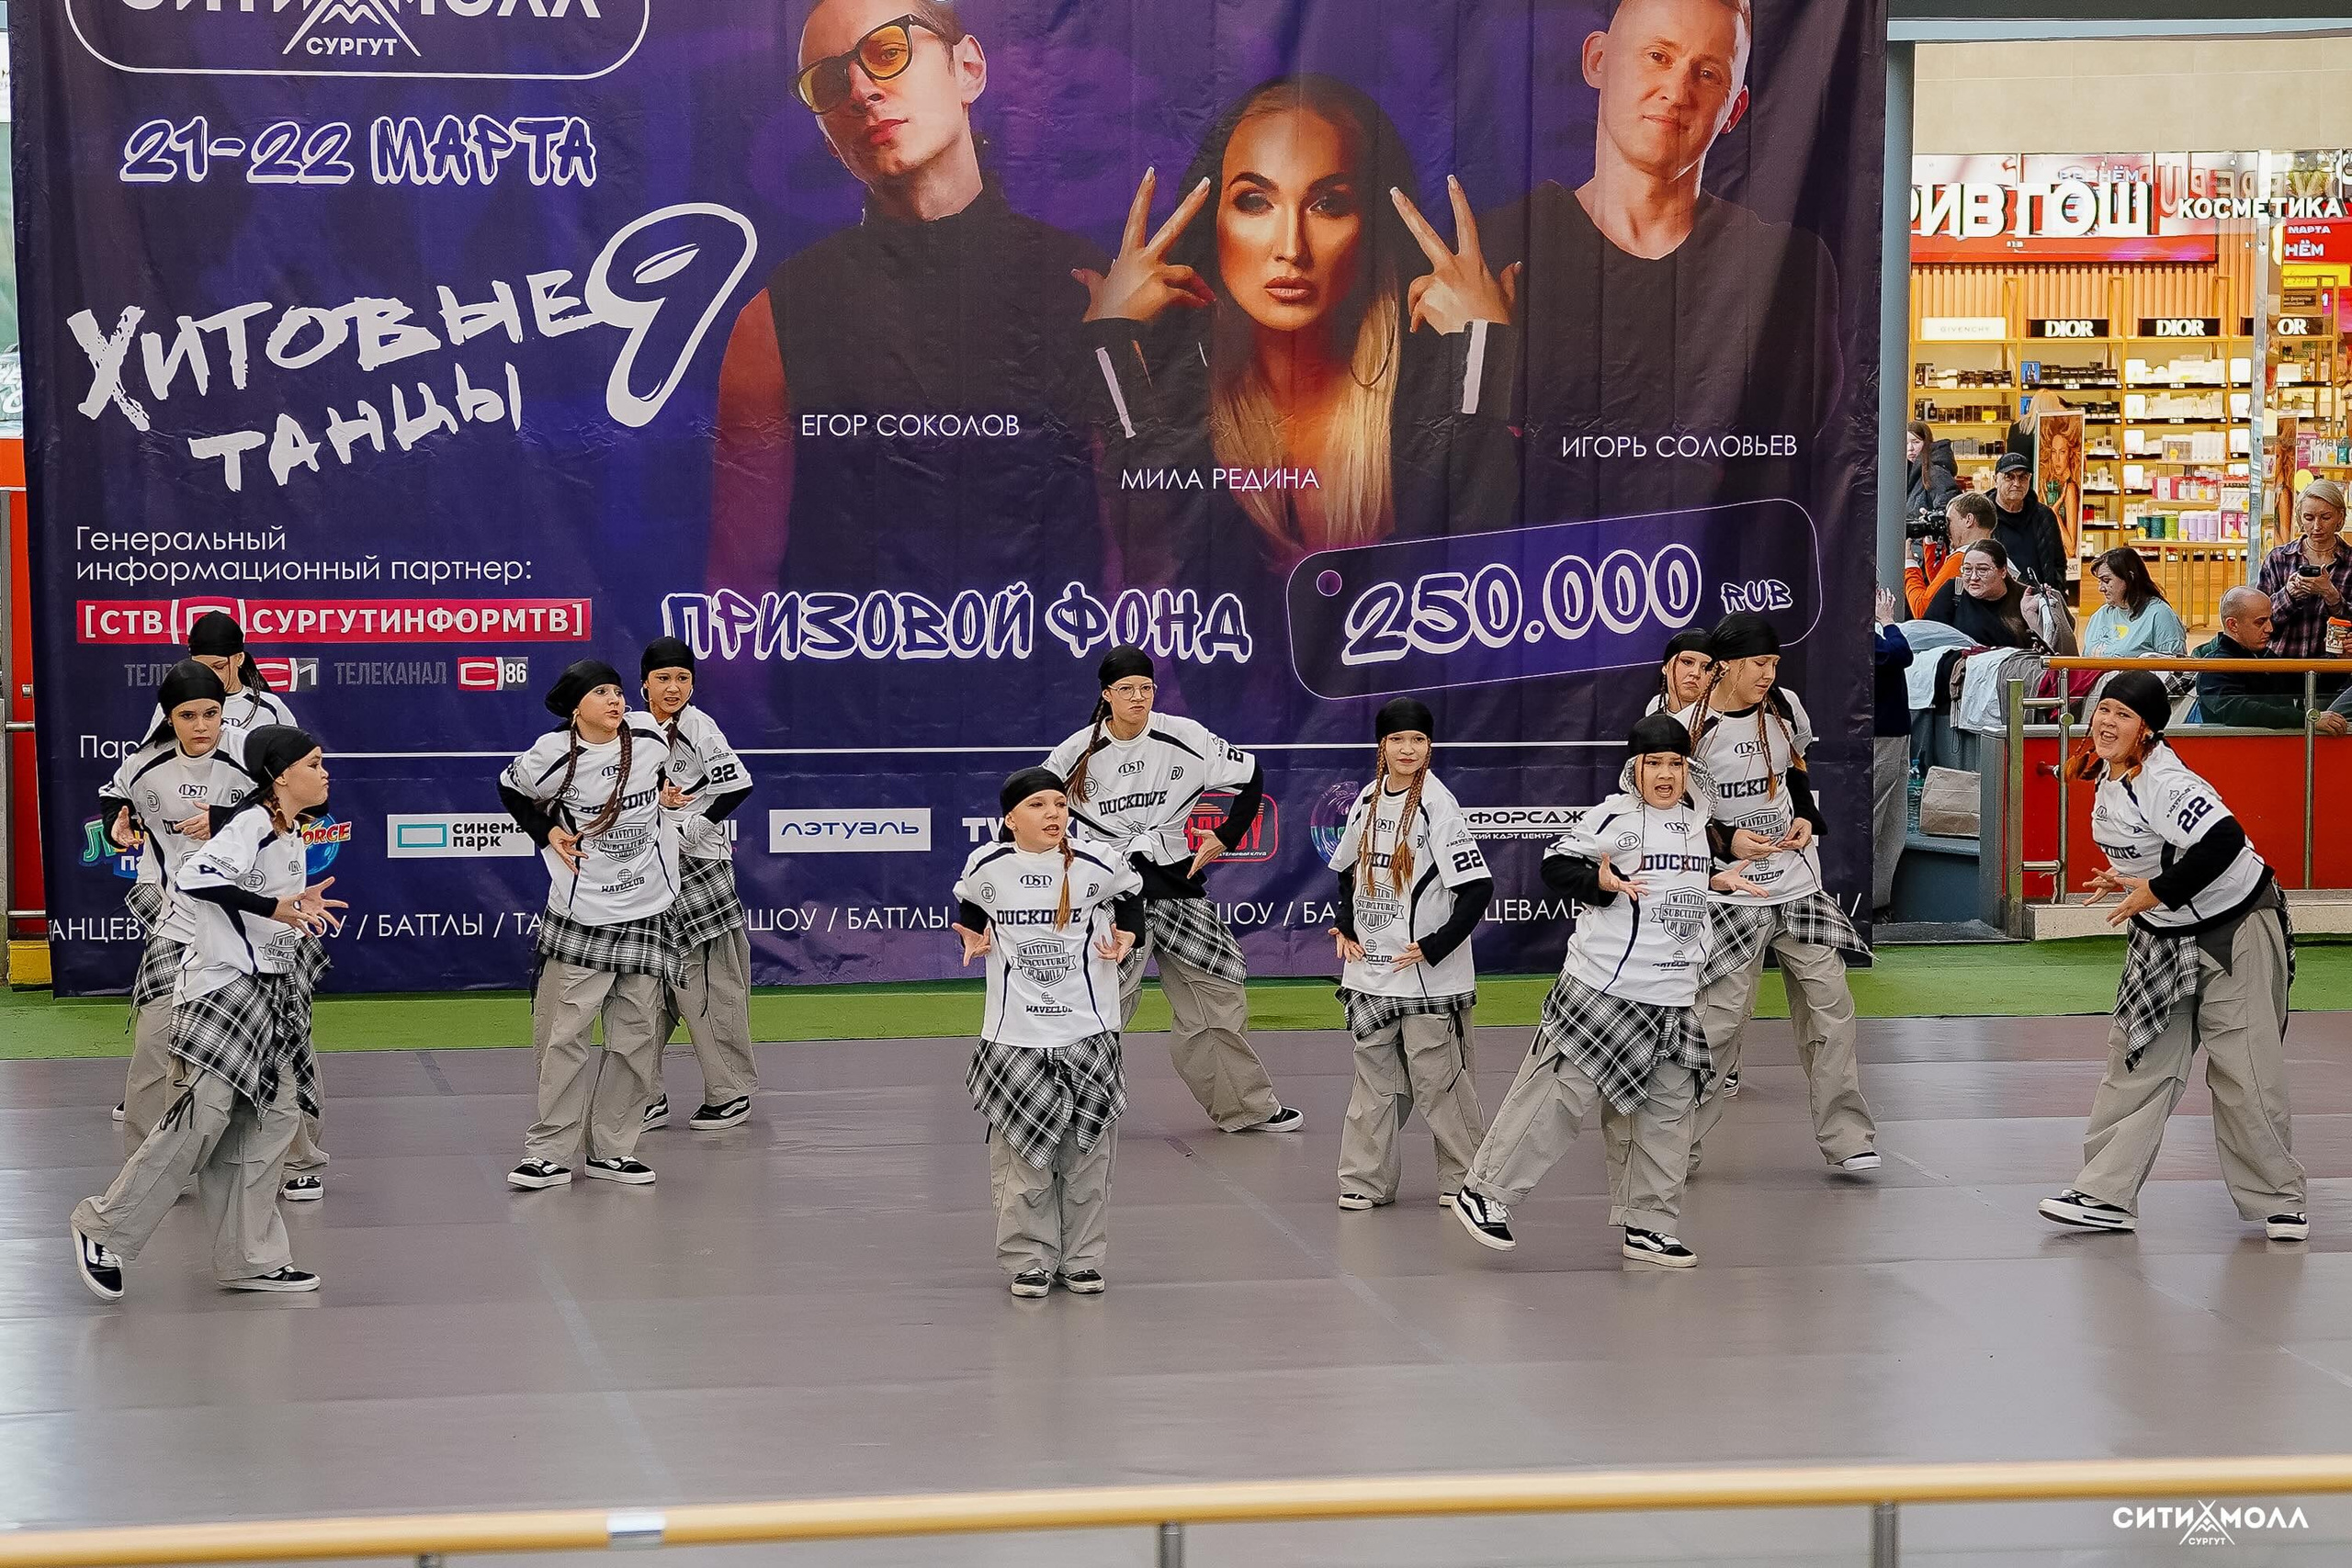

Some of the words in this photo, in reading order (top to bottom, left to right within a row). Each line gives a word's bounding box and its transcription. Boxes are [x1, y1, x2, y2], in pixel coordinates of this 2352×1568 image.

[306, 37, 398, 56] СУРГУТ
[119, 116, 355, 185] 21-22
[370, 114, 597, 187] МАРТА
[1911, 182, 2007, 238] ИВ
[2016, 178, 2152, 238] ГОШ
[2177, 196, 2344, 220] КОСМЕТИКА
[2288, 225, 2332, 234] МАРТА
[2284, 239, 2324, 257] НЁМ
[2045, 320, 2095, 338] DIOR
[2155, 319, 2206, 337] DIOR
[2277, 318, 2308, 335] OR
[66, 269, 593, 432] ХИТОВЫЕ
[189, 361, 524, 492] ТАНЦЫ
[801, 413, 867, 437] ЕГОР
[876, 413, 1020, 437] СОКОЛОВ
[1561, 435, 1647, 458] ИГОРЬ
[1655, 434, 1798, 458] СОЛОВЬЕВ
[1120, 468, 1204, 491] МИЛА
[1212, 467, 1320, 492] РЕДИНА
[76, 525, 287, 556] Генеральный
[76, 554, 380, 587] информационный
[390, 558, 533, 587] партнер:
[1341, 543, 1703, 666] 250.000
[1720, 578, 1792, 615] RUB
[661, 581, 1034, 661] ПРИЗОВОЙ
[1045, 581, 1253, 664] ФОНД
[334, 661, 447, 685] ТЕЛЕКАНАЛ
[710, 762, 740, 785] 22
[1098, 789, 1168, 817] DUCKDIVE
[2177, 795, 2215, 835] 22
[452, 821, 526, 834] синема
[1469, 810, 1588, 825] ФОРСАЖ
[301, 821, 353, 846] ORCE
[452, 835, 502, 852] парк
[1521, 832, 1555, 840] ЦЕНТР
[747, 907, 818, 932] ШОУ
[847, 906, 949, 931] БАТТЛЫ
[996, 907, 1082, 925] DUCKDE
[1485, 897, 1587, 924] ЦЕВАЛЬ
[378, 912, 483, 938] БАТТЛЫ
